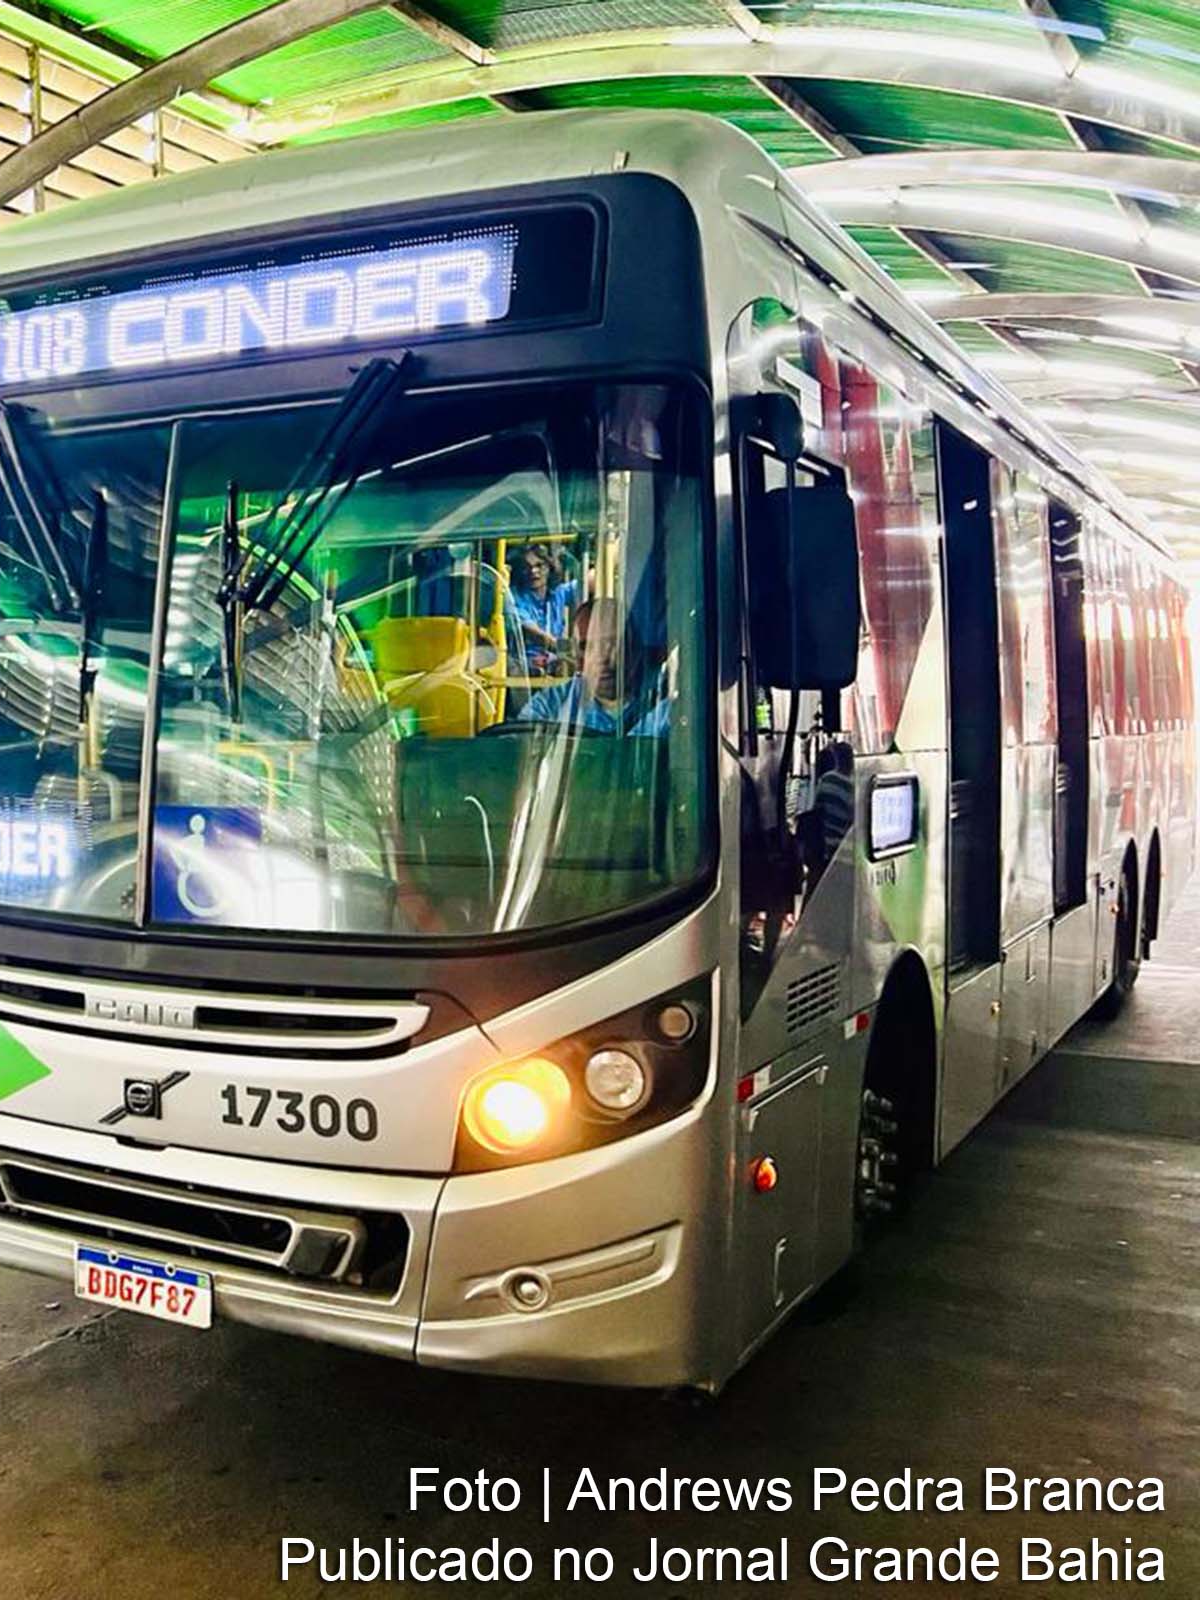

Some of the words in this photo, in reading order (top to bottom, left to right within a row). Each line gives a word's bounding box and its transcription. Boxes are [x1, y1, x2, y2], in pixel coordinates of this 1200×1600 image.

[108, 246, 494, 366] CONDER
[221, 1084, 379, 1142] 17300
[88, 1266, 196, 1317] BDG7F87
